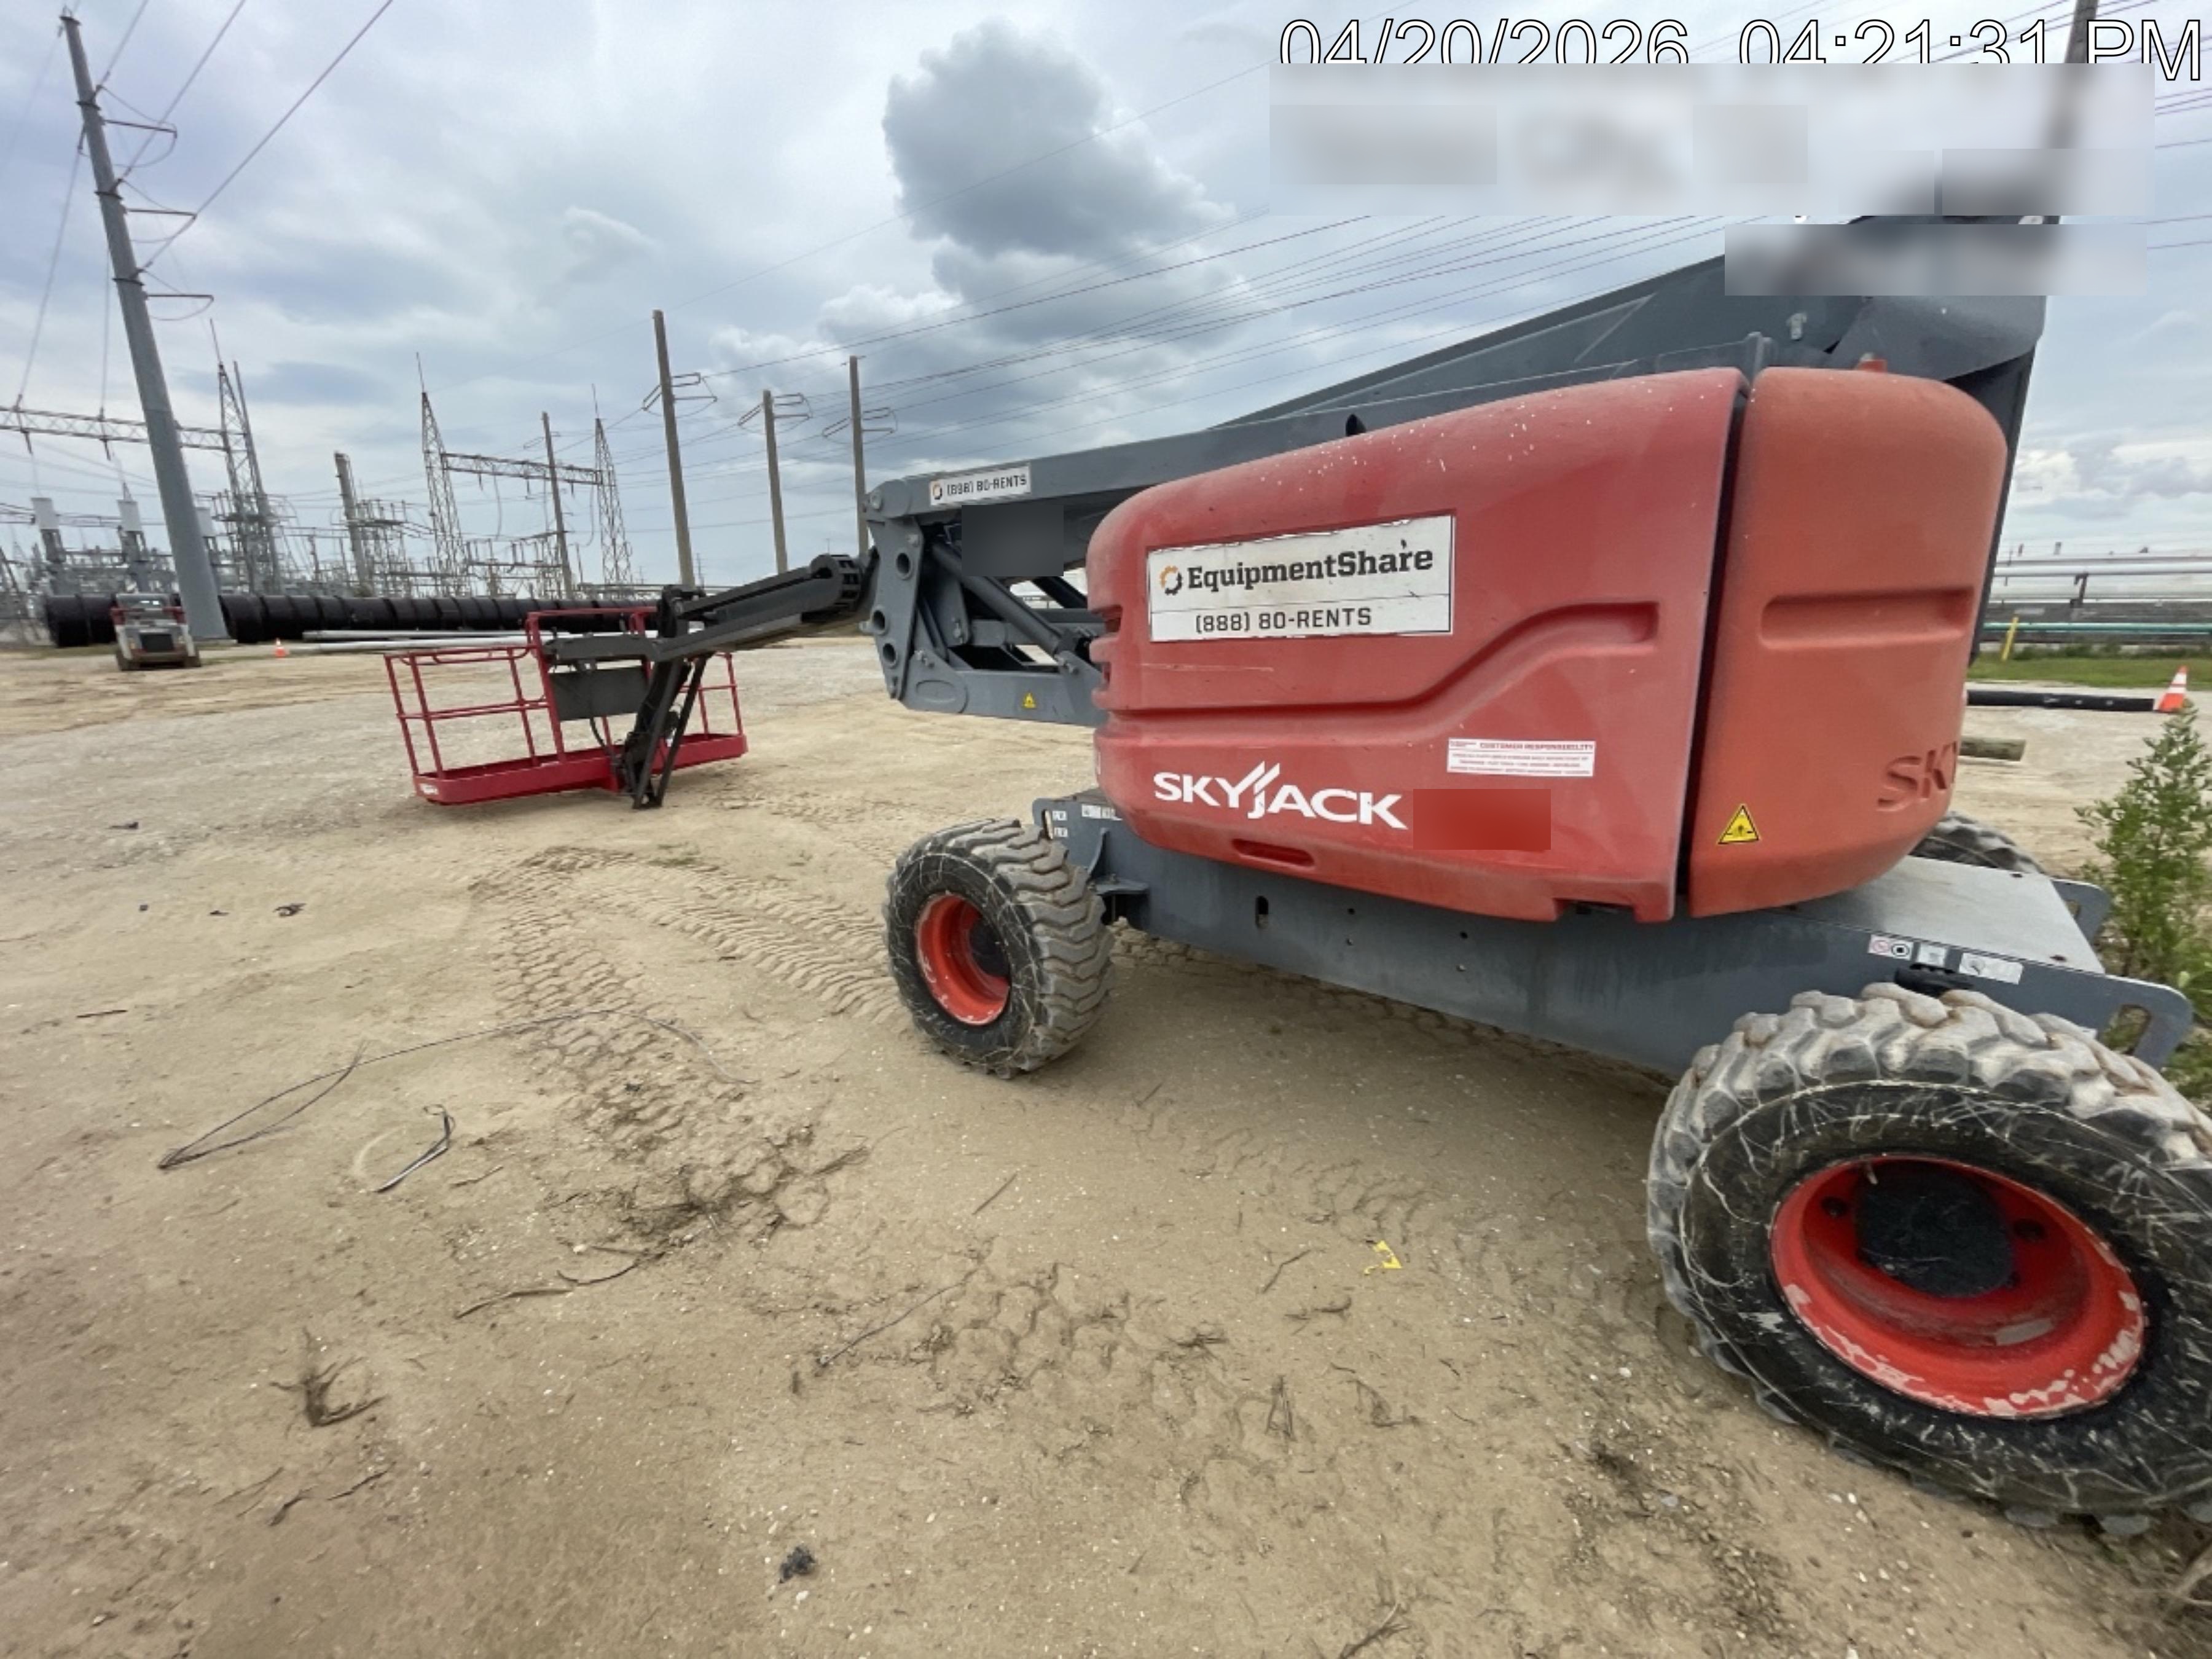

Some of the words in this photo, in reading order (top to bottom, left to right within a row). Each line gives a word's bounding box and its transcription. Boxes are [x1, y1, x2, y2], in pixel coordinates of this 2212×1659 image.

[1187, 547, 1433, 592] EquipmentShare
[1196, 613, 1250, 633] (888)
[1258, 607, 1372, 630] 80-RENTS
[1153, 760, 1408, 830] SKYJACK
[1877, 741, 1956, 810] SK
